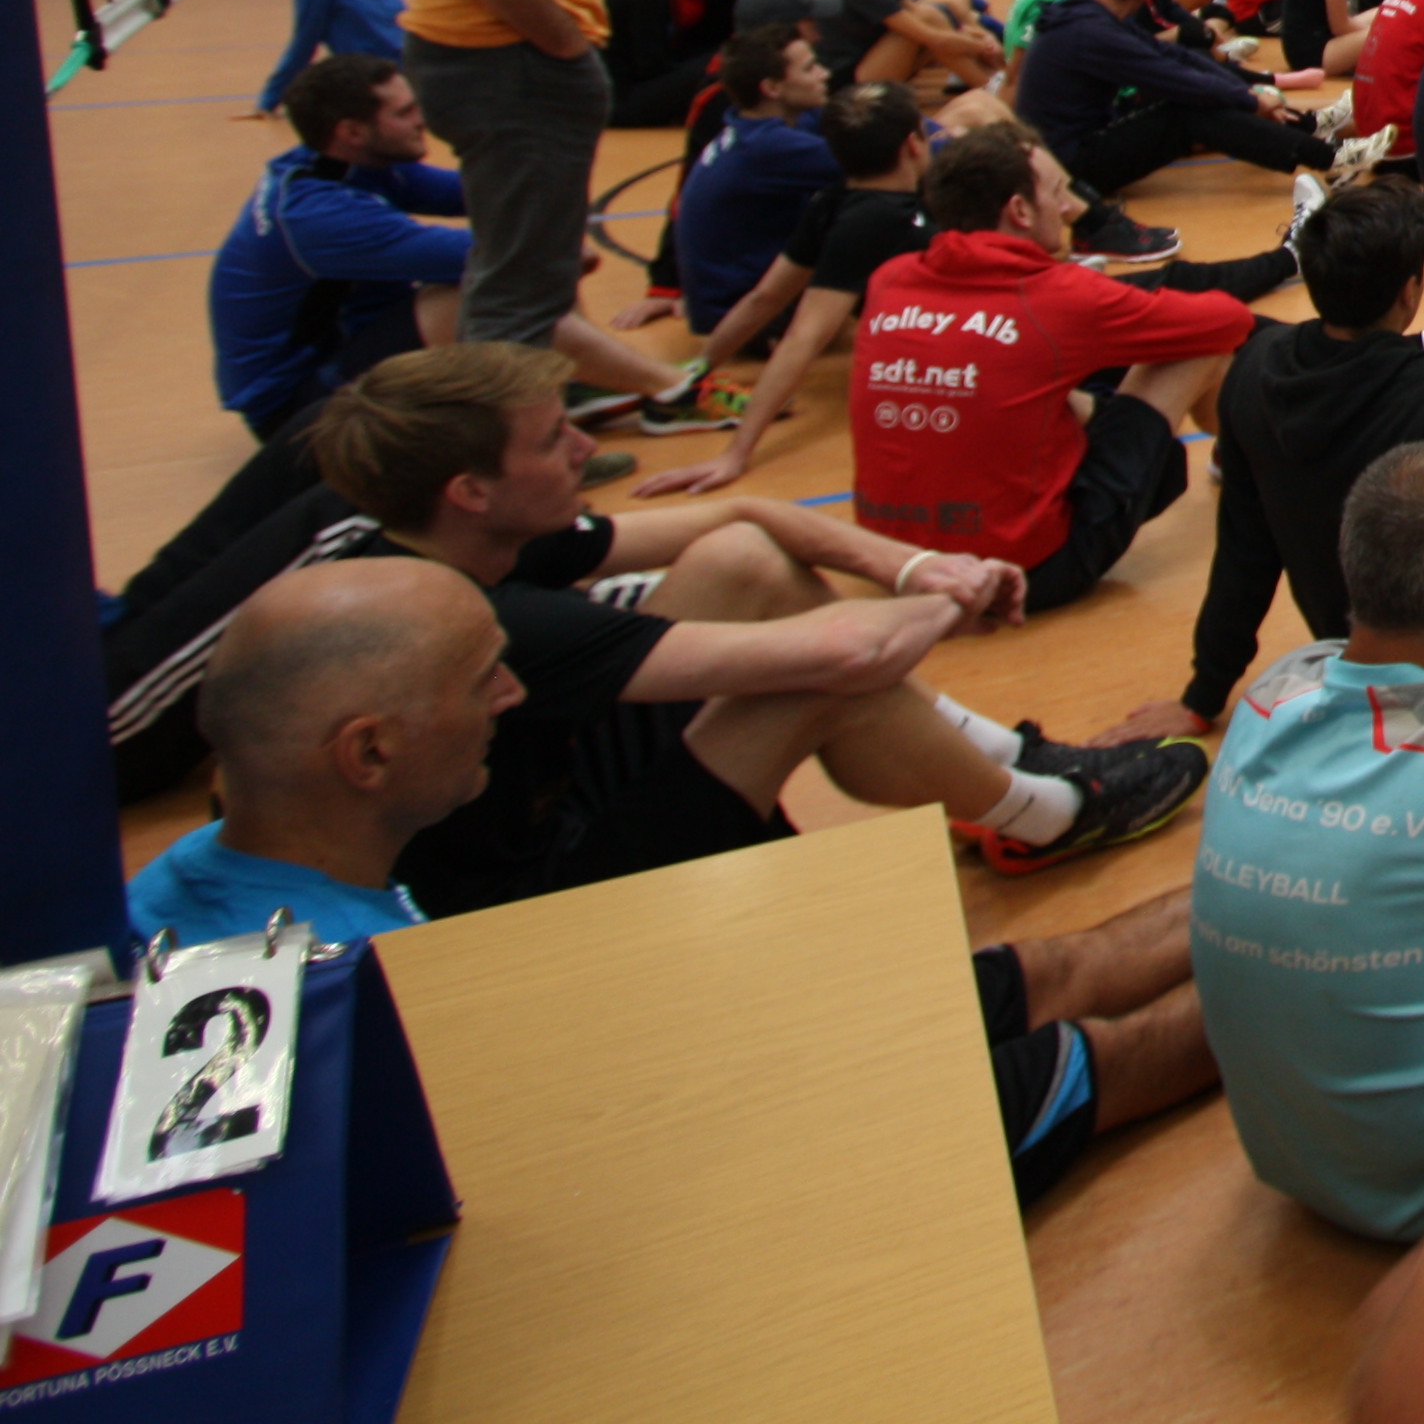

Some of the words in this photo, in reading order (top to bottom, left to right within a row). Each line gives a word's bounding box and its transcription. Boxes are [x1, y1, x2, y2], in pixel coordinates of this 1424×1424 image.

[869, 358, 978, 388] sdt.net
[1243, 782, 1309, 823] Jena
[1201, 846, 1349, 906] OLLEYBALL
[1225, 935, 1264, 959] am
[1268, 945, 1423, 974] schönsten
[147, 986, 272, 1162] 2
[54, 1238, 167, 1341] F
[0, 1372, 90, 1408] FORTUNA
[95, 1343, 202, 1385] PÖSSNECK
[206, 1333, 239, 1358] E.V.
